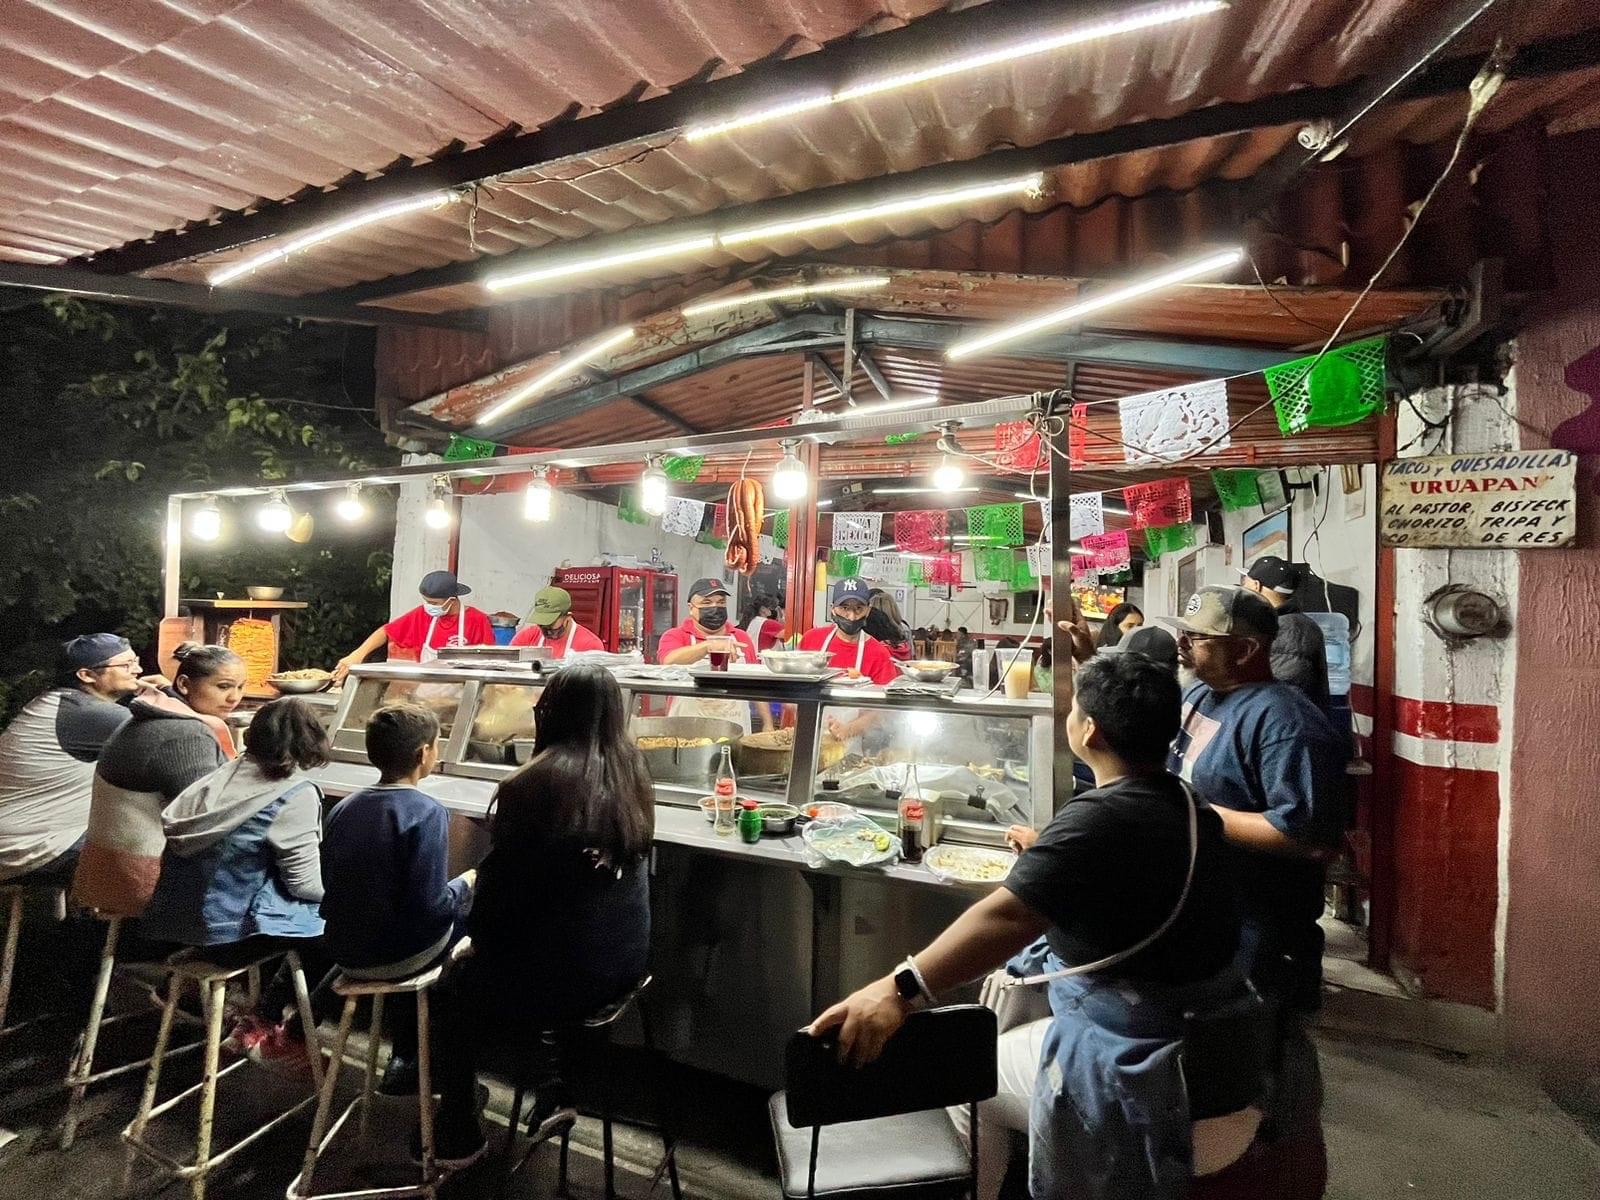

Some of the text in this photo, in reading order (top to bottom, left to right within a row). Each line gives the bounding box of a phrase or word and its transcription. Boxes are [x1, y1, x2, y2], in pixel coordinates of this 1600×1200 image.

[1388, 461, 1431, 475] TACOS
[1451, 452, 1573, 474] QUESADILLAS
[1385, 503, 1405, 515] AL
[1491, 499, 1571, 512] BISTECK
[1480, 516, 1542, 528] TRIPA
[1552, 515, 1567, 526] Y
[1480, 532, 1510, 543] DE
[1518, 531, 1564, 543] RES
[564, 573, 601, 581] DELICIOSA
